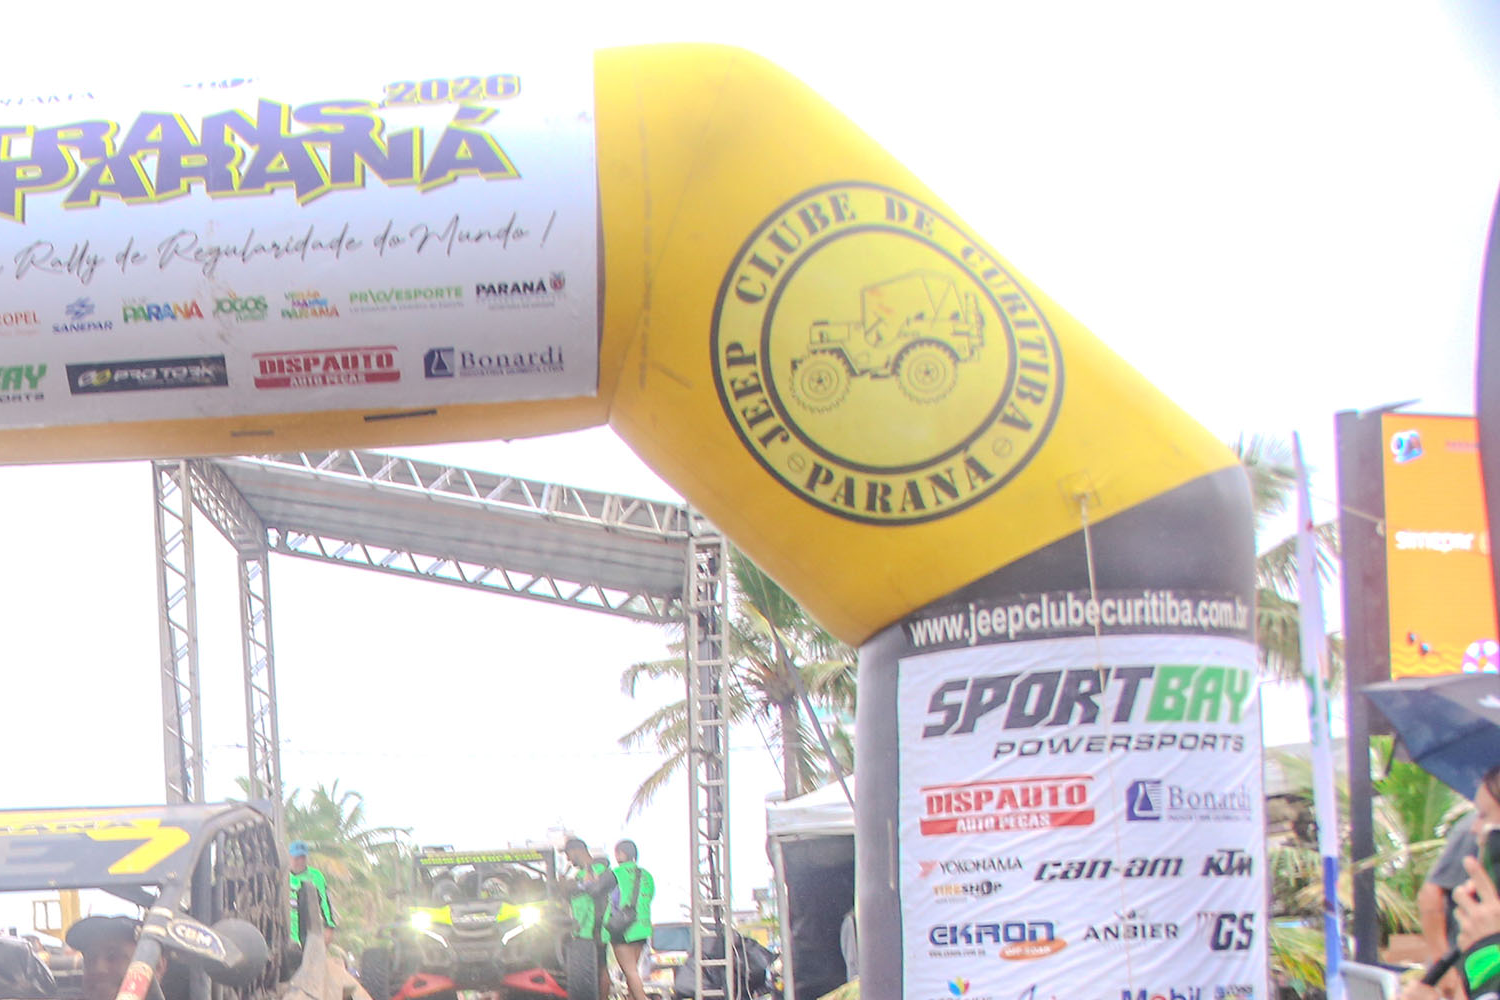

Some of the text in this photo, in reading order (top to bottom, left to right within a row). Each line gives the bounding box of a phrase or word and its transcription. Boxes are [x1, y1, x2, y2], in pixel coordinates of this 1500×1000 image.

[382, 73, 522, 105] 2026
[14, 240, 104, 286] Rally
[116, 236, 148, 274] de
[158, 223, 362, 280] Regularidade
[373, 219, 404, 257] do
[409, 211, 530, 257] Mundo
[475, 278, 547, 298] PARANÁ
[122, 300, 204, 323] PARANÁ
[724, 192, 1052, 451] JEEP CLUBE DE CURITIBA
[52, 320, 114, 335] SANEPAR
[259, 352, 395, 376] DISPAUTO
[459, 345, 565, 370] Bonardi
[803, 448, 996, 516] PARANÁ
[909, 590, 1250, 648] www.jeepclubecuritiba.com.br
[992, 733, 1246, 760] POWERSPORTS
[925, 783, 1089, 817] DISPAUTO
[1167, 784, 1253, 811] Bonardi
[84, 824, 191, 876] 7
[1200, 849, 1253, 877] KTM
[939, 856, 1023, 875] YOKOHAMA
[1033, 856, 1184, 881] can-am
[1083, 923, 1179, 941] ANBIER
[1210, 912, 1256, 952] GS
